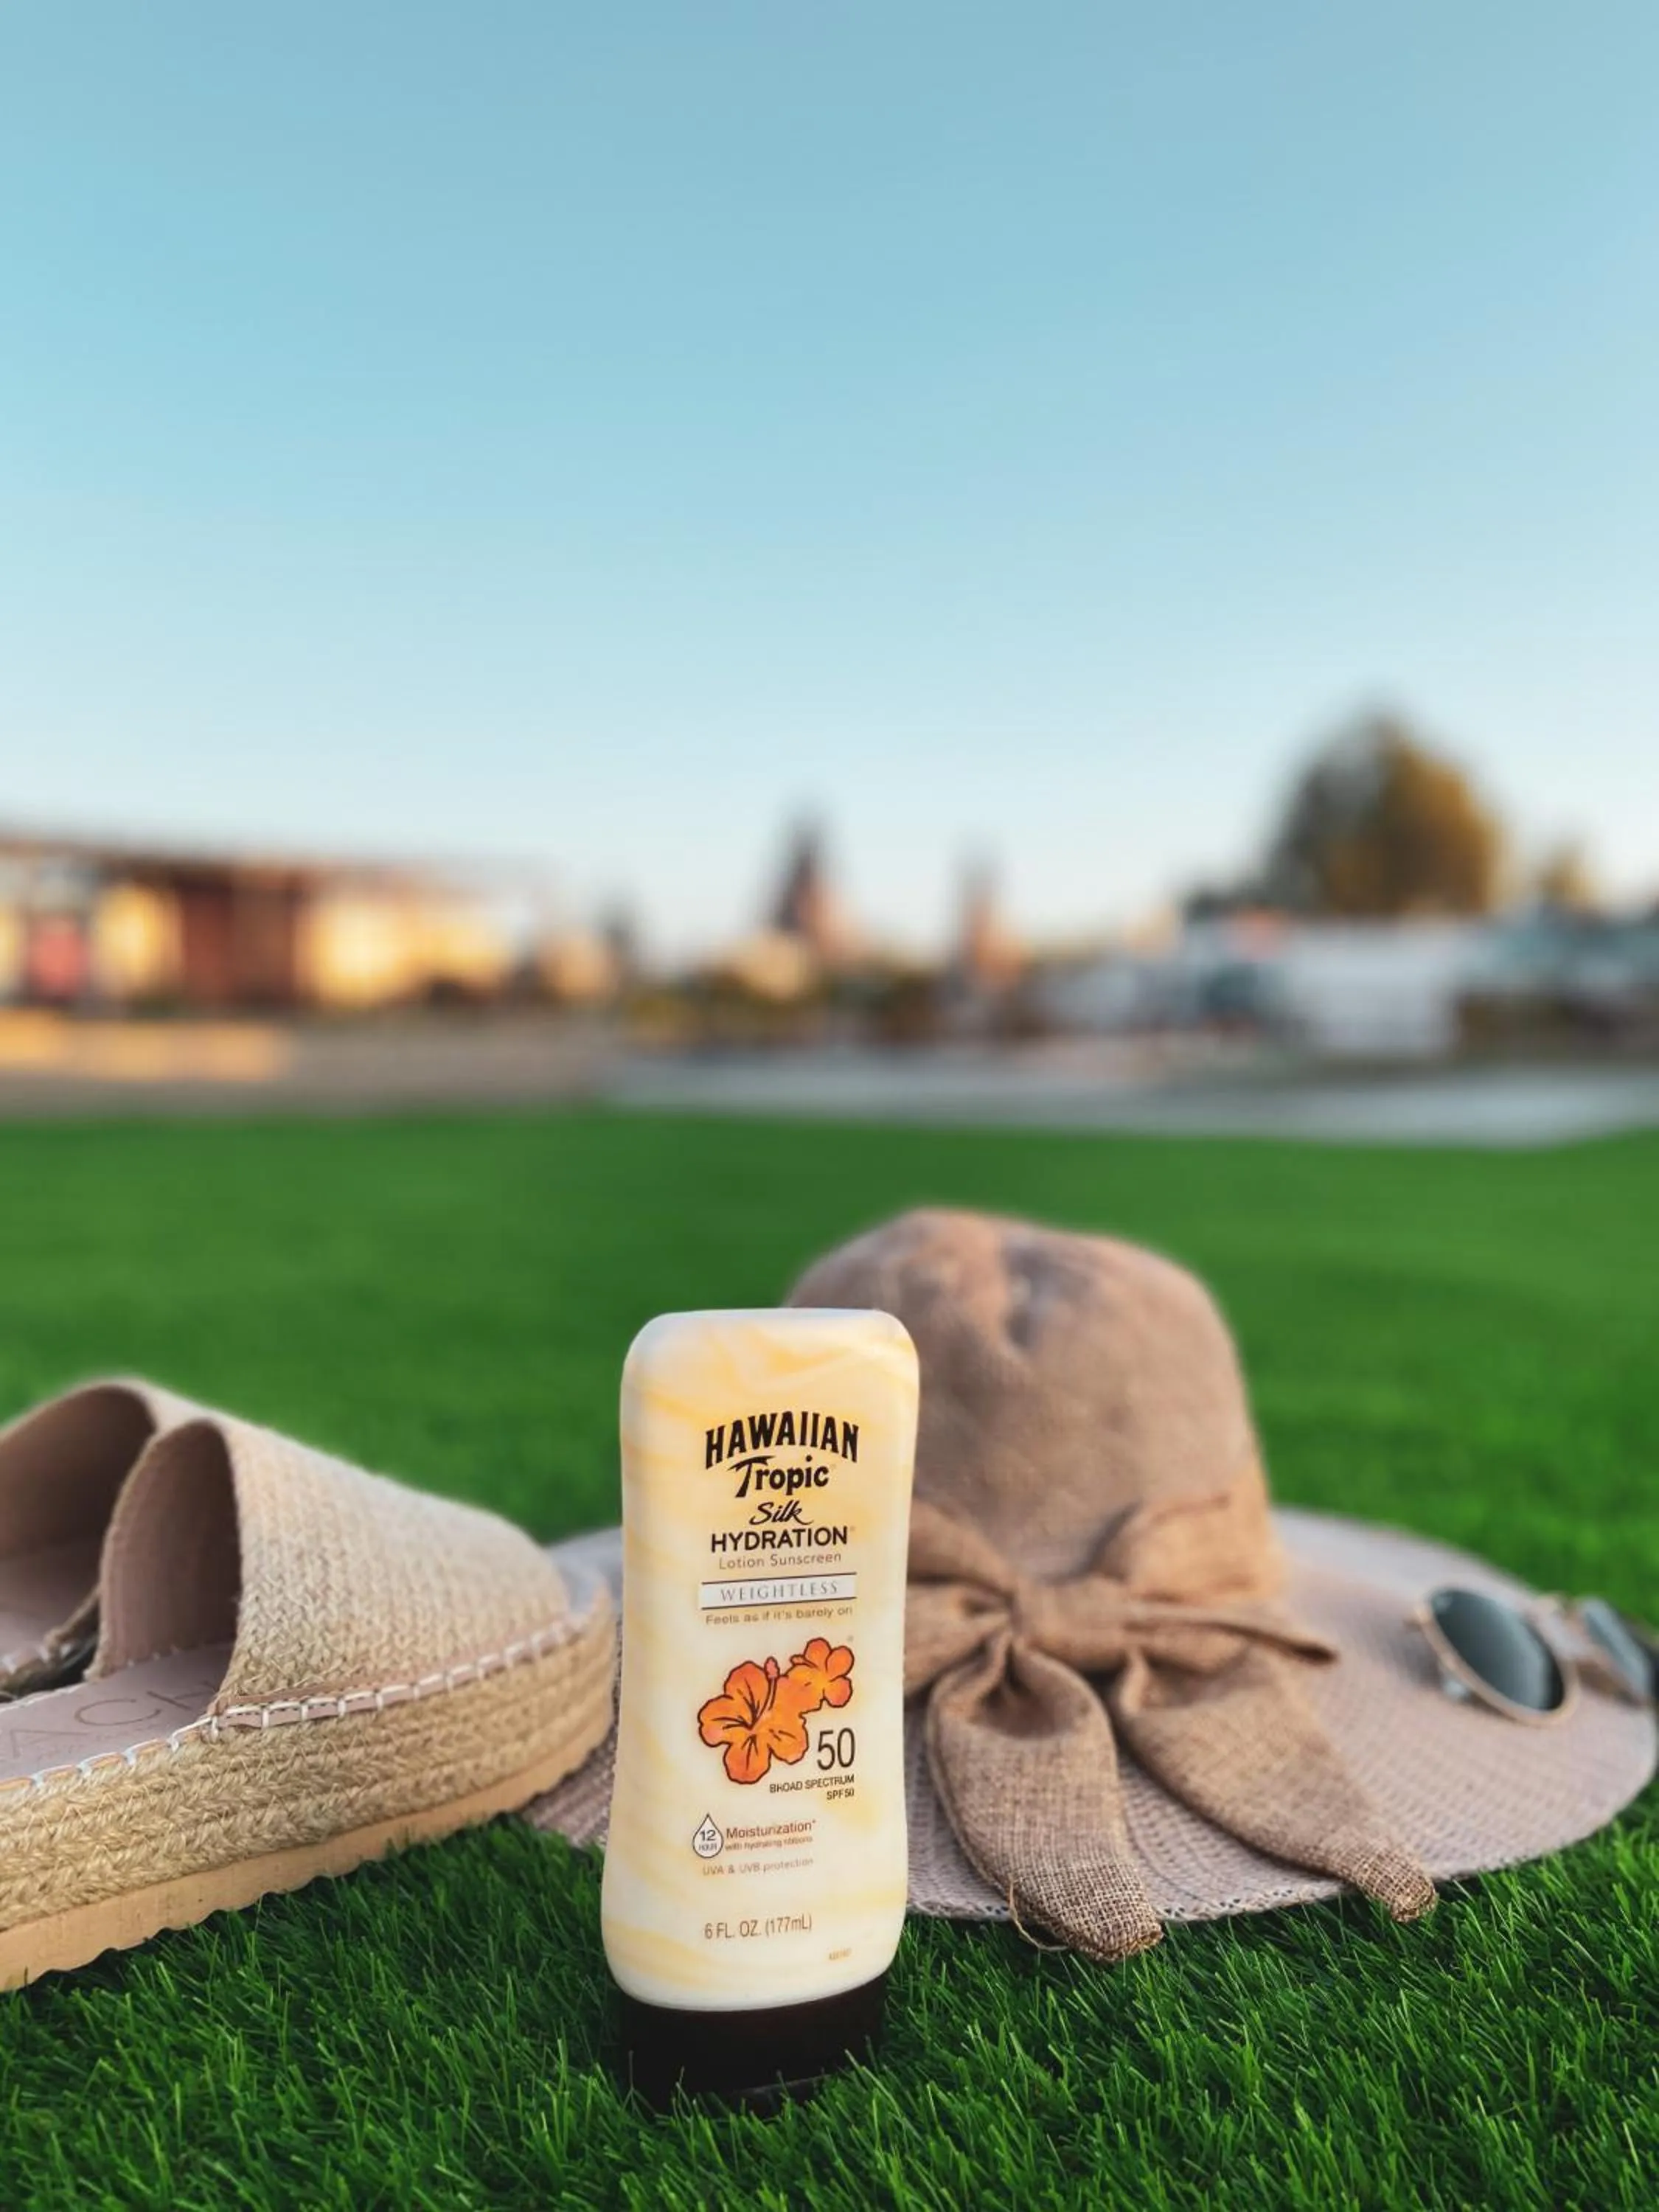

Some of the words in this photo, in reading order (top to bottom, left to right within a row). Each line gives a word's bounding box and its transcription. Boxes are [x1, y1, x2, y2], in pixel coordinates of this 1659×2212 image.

[706, 1411, 859, 1470] HAWAIIAN
[727, 1455, 830, 1498] Tropic
[748, 1500, 814, 1526] Silk
[711, 1526, 848, 1553] HYDRATION
[719, 1556, 765, 1570] Lotion
[770, 1552, 841, 1567] Sunscreen
[720, 1581, 838, 1601] WEIGHTLESS
[706, 1613, 740, 1625] Feels
[743, 1613, 758, 1622] as
[762, 1610, 769, 1621] if
[773, 1610, 792, 1621] it's
[796, 1607, 834, 1620] barely
[838, 1606, 853, 1615] on
[817, 1728, 855, 1770] 50
[769, 1781, 803, 1793] BROAD
[804, 1774, 855, 1790] SPECTRUM
[827, 1789, 844, 1801] SPF
[844, 1787, 855, 1798] 50
[700, 1829, 716, 1840] 12
[703, 1865, 724, 1876] UVA
[739, 1863, 761, 1874] UVB
[763, 1857, 813, 1874] protection
[704, 1922, 712, 1939] 6
[716, 1921, 735, 1939] FL.
[765, 1913, 813, 1938] (177mL)
